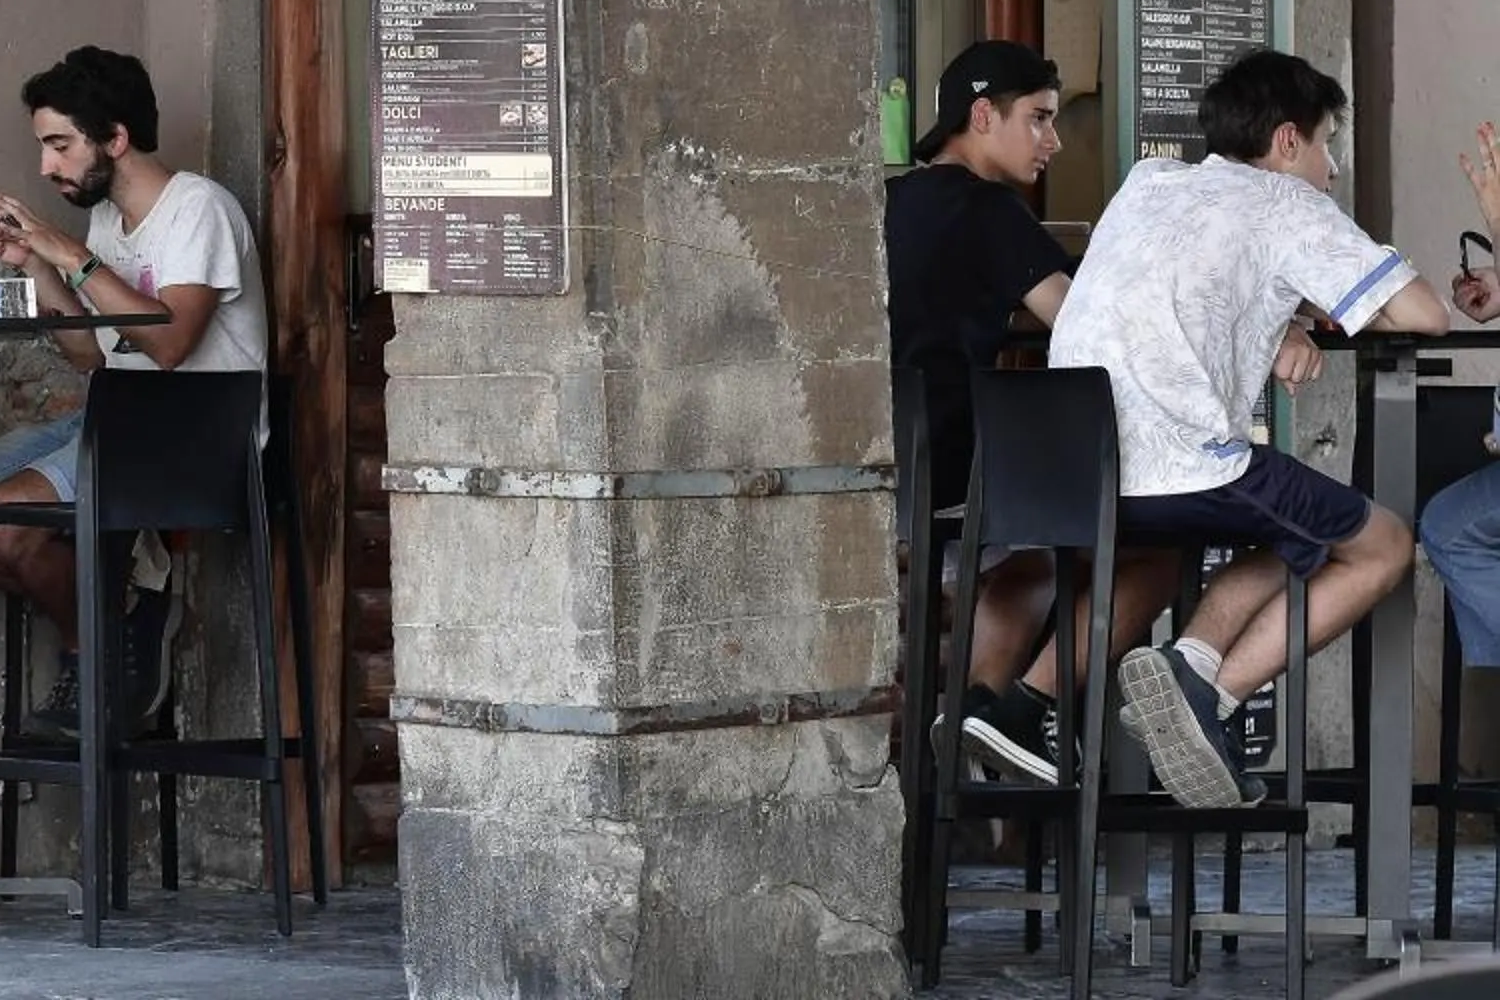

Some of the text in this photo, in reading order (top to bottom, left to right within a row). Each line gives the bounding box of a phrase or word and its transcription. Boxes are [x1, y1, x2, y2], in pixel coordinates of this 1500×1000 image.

[380, 45, 439, 60] TAGLIERI
[382, 105, 421, 120] DOLCI
[1141, 141, 1183, 160] PANINI
[416, 155, 467, 168] STUDENTI
[385, 198, 445, 211] BEVANDE
